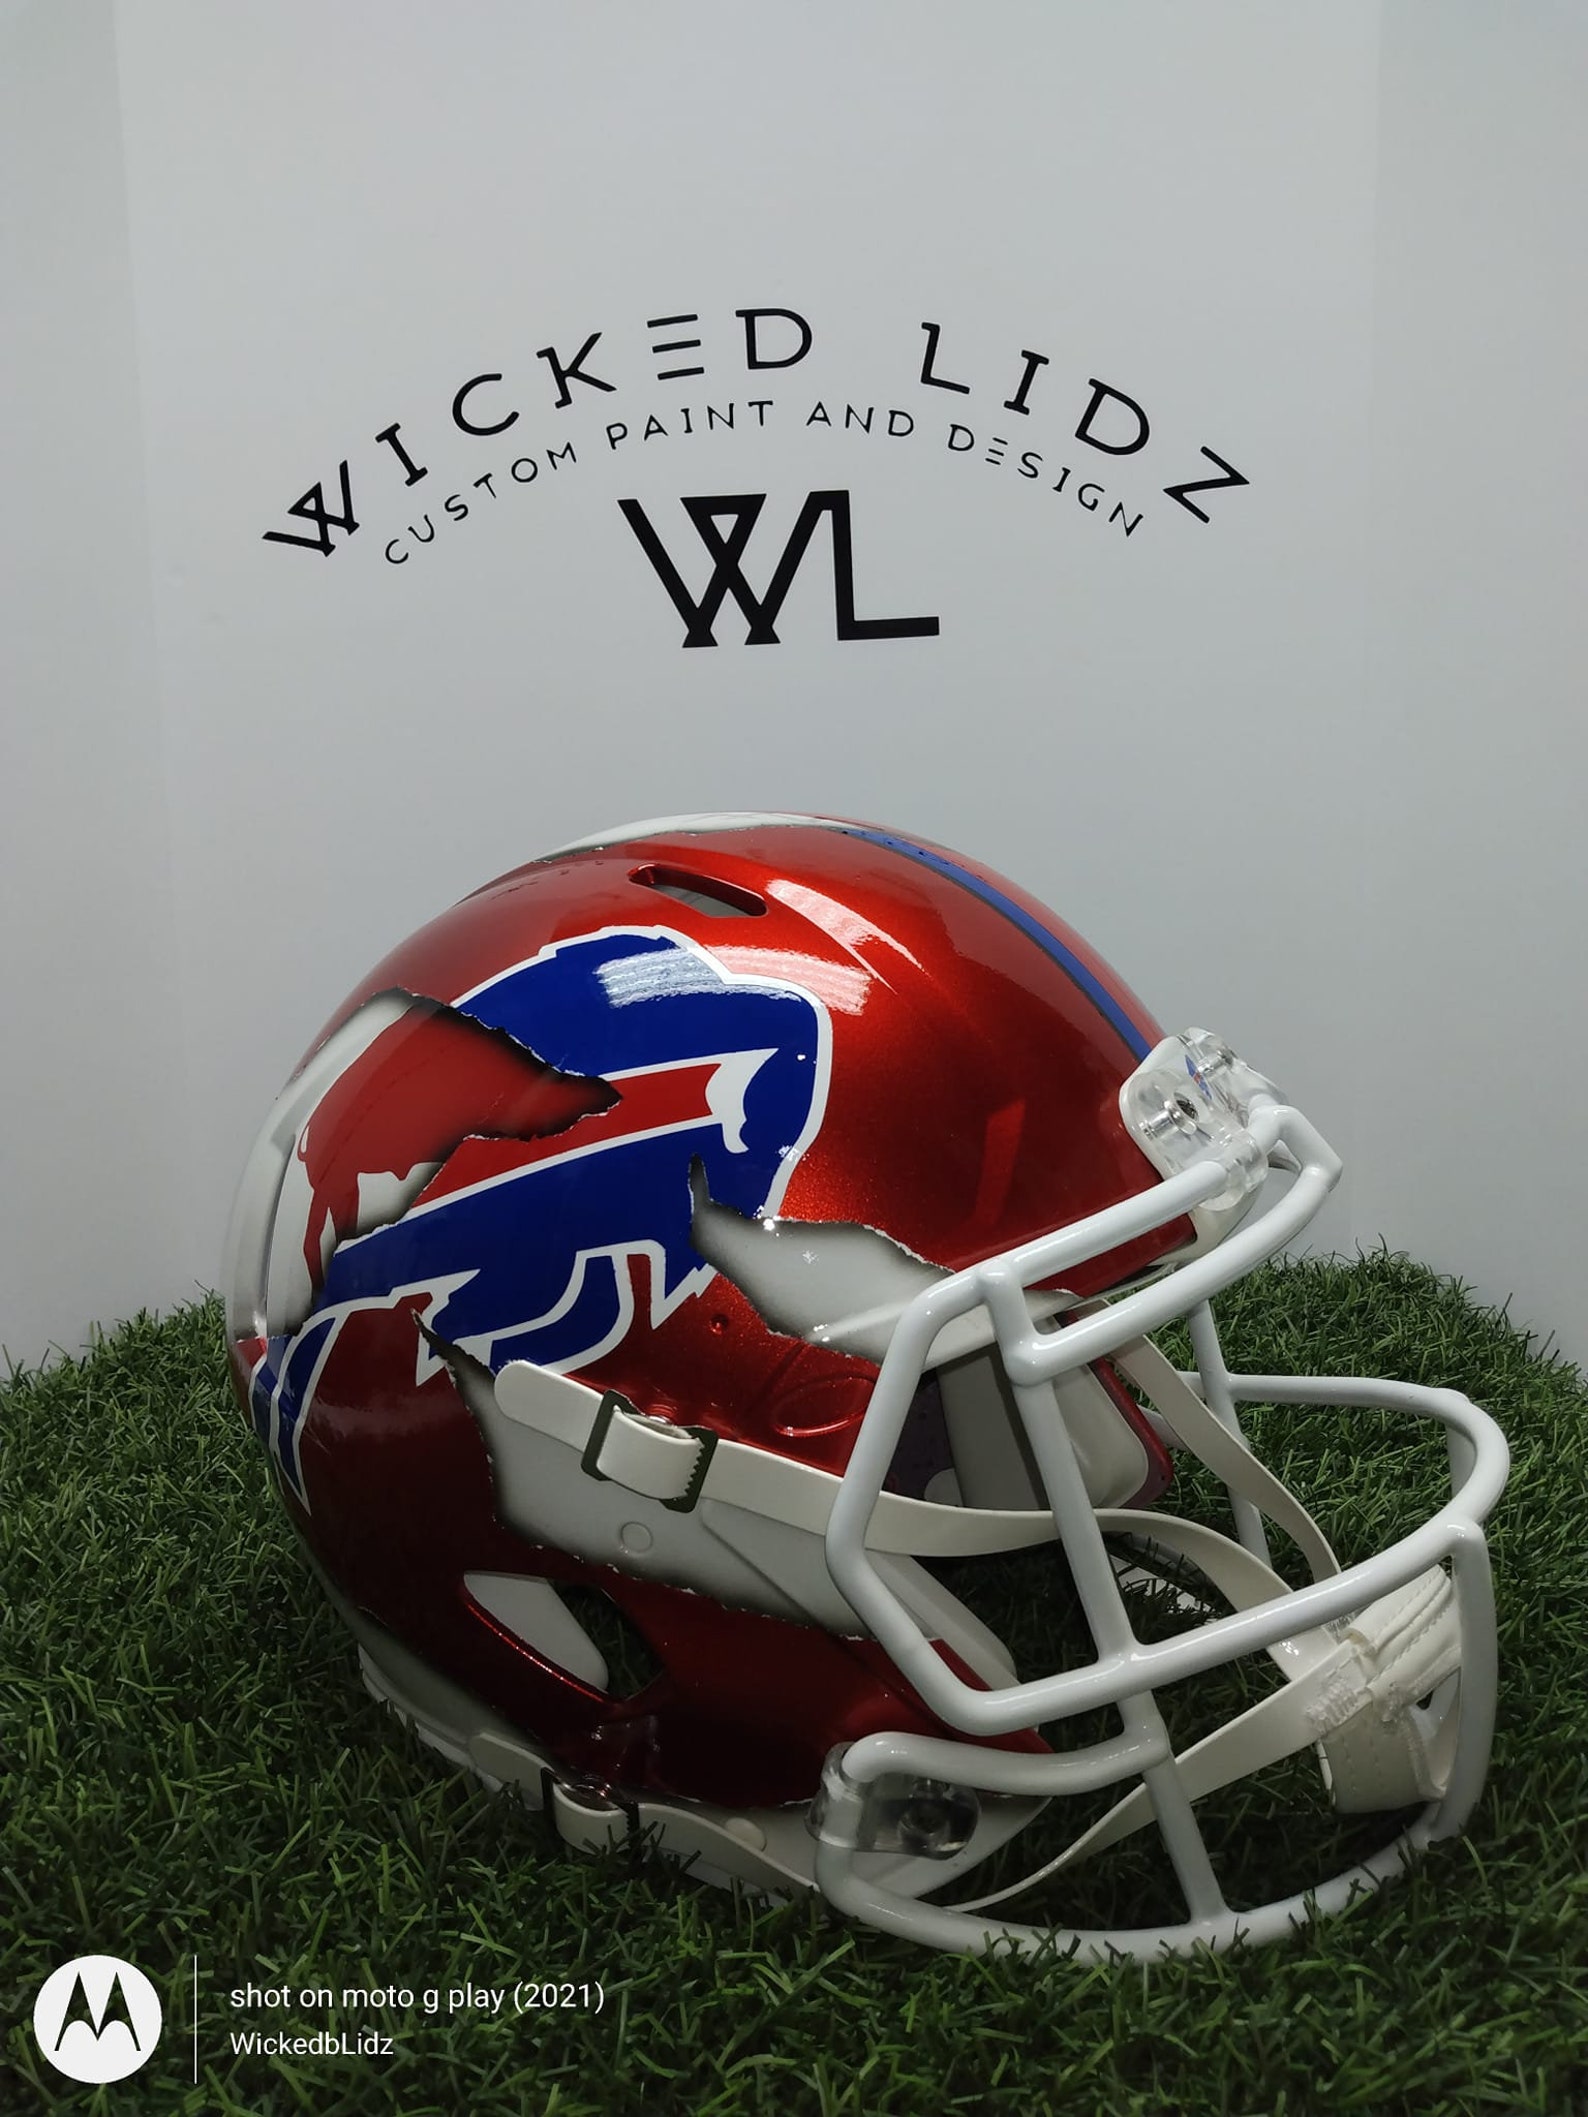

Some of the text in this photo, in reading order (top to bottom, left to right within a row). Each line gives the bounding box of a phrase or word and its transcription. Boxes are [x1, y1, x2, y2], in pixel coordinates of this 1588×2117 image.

[261, 307, 1250, 558] WICKED LIDZ
[384, 400, 1144, 565] CUSTOM PAINT AND DESIGN
